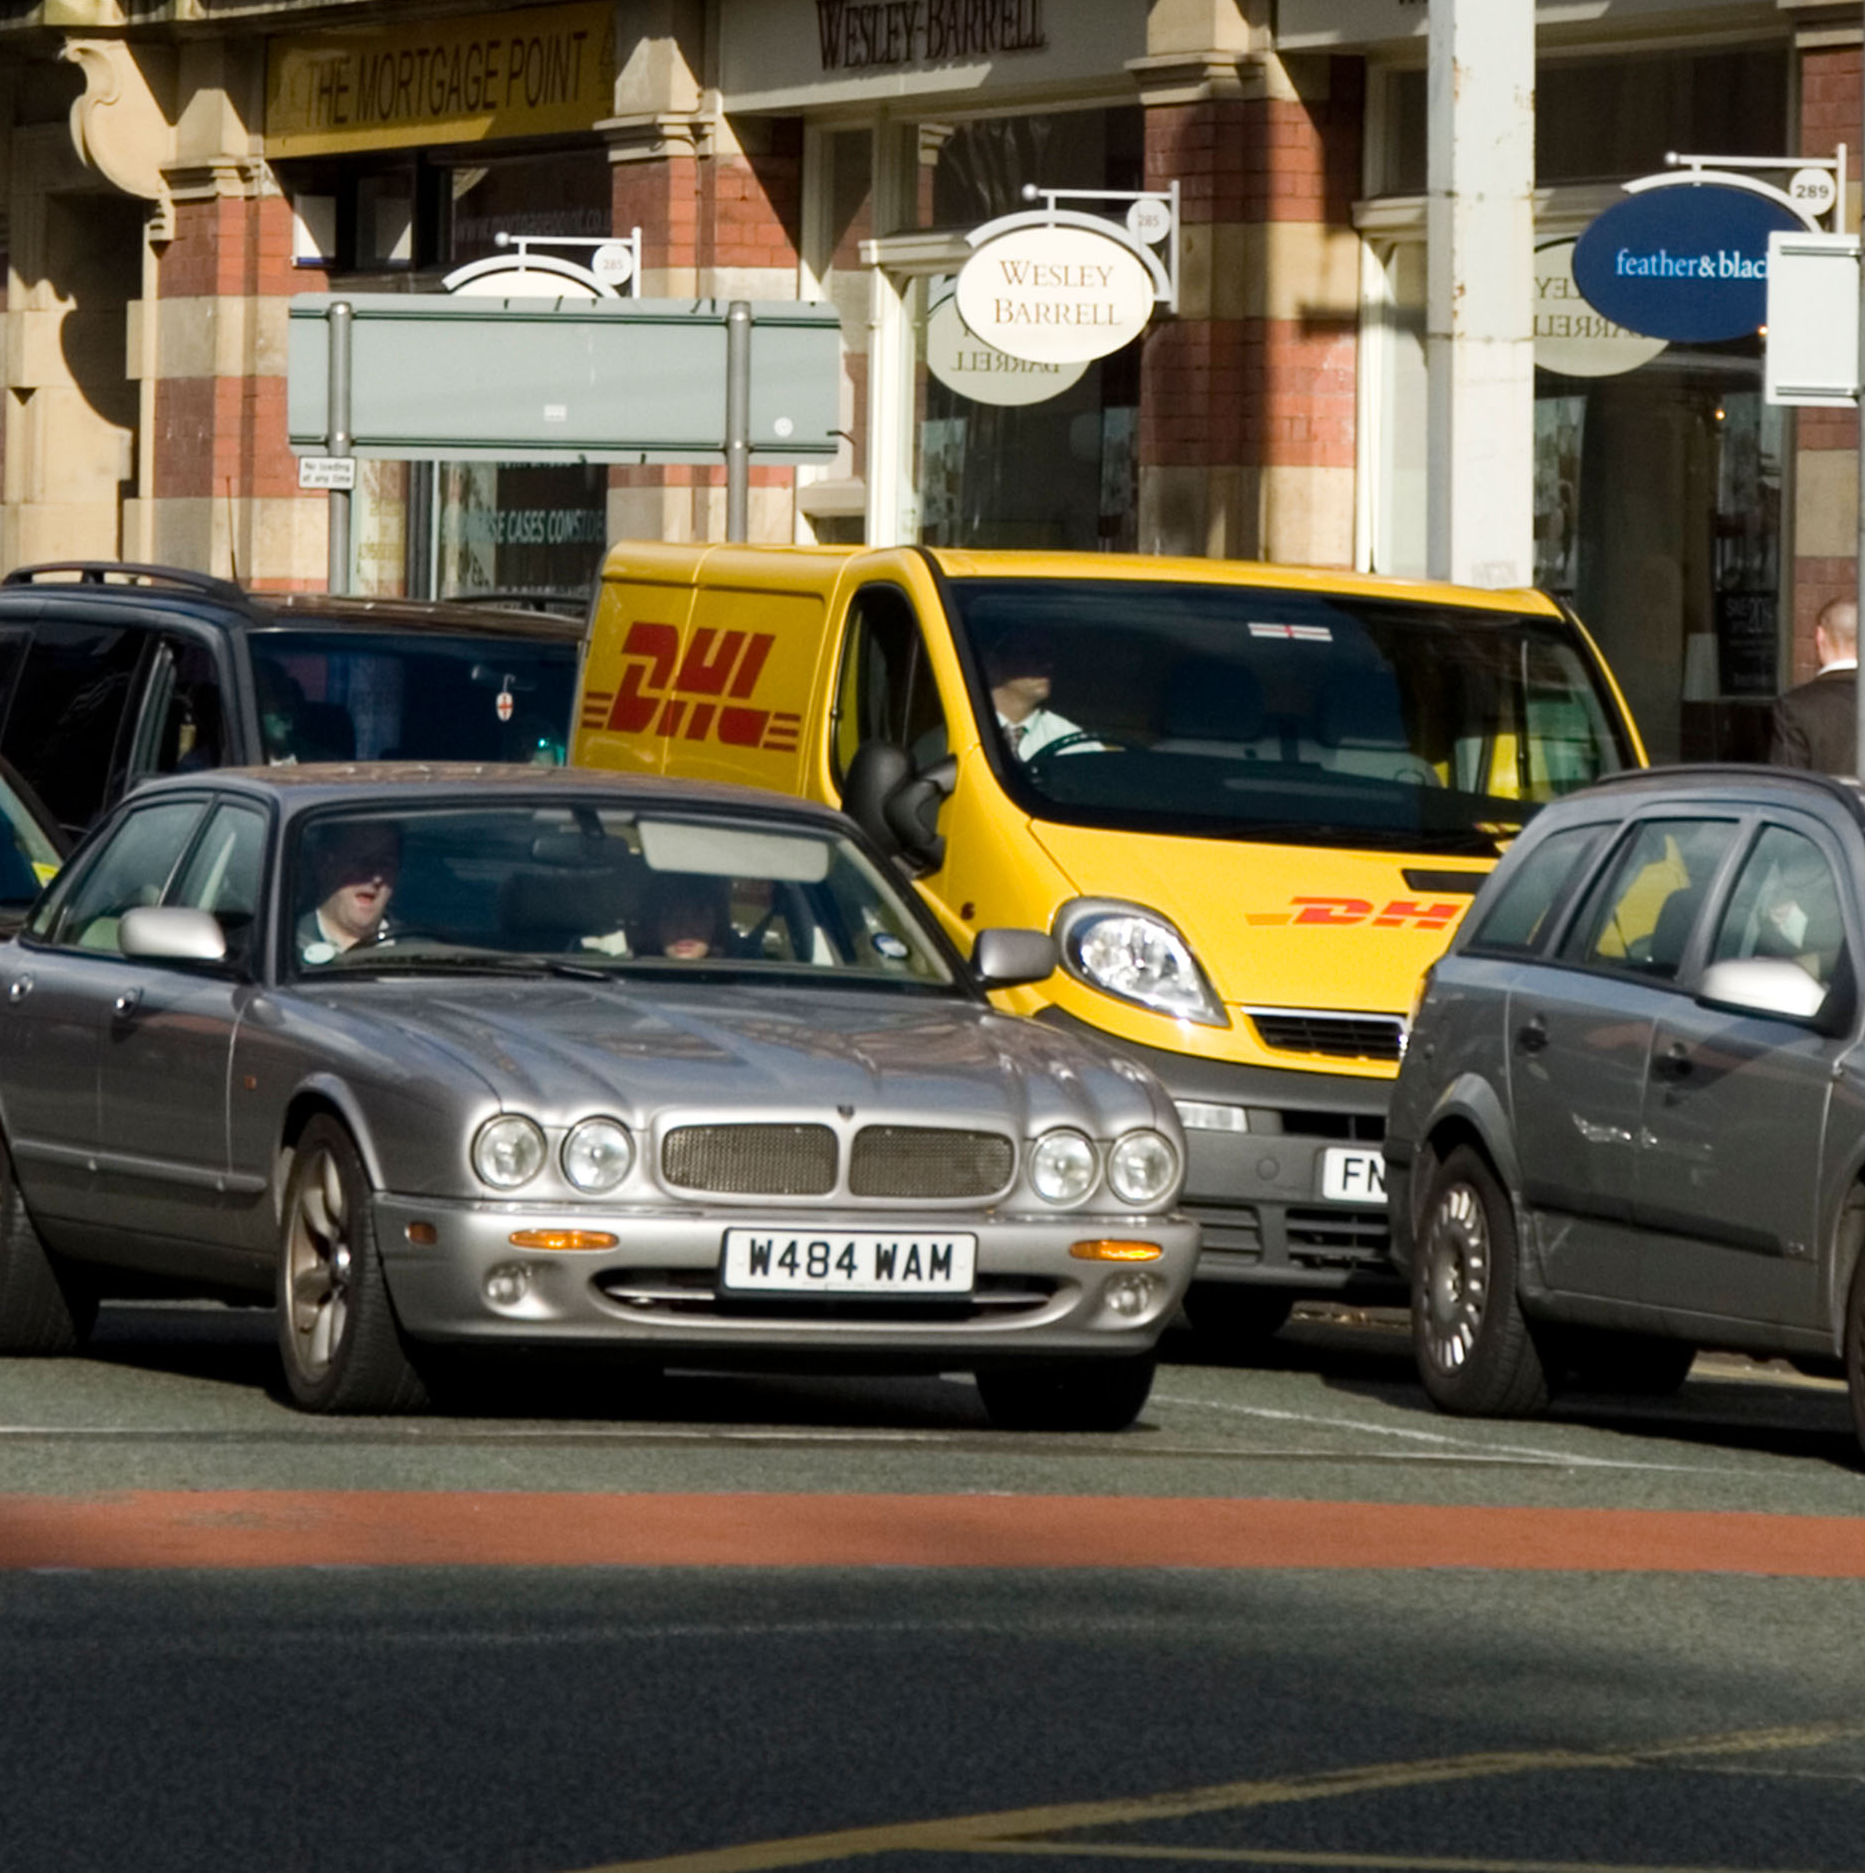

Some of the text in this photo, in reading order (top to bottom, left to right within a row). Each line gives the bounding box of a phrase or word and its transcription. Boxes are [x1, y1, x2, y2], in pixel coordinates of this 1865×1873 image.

[307, 30, 589, 127] THE MORTGAGE POINT
[1795, 184, 1830, 199] 289
[999, 259, 1115, 288] WESLEY
[1615, 246, 1767, 279] feather&blac
[994, 297, 1124, 326] BARRELL
[507, 509, 546, 544] CASES
[608, 621, 776, 748] DHL
[749, 1238, 953, 1282] W484 WAM
